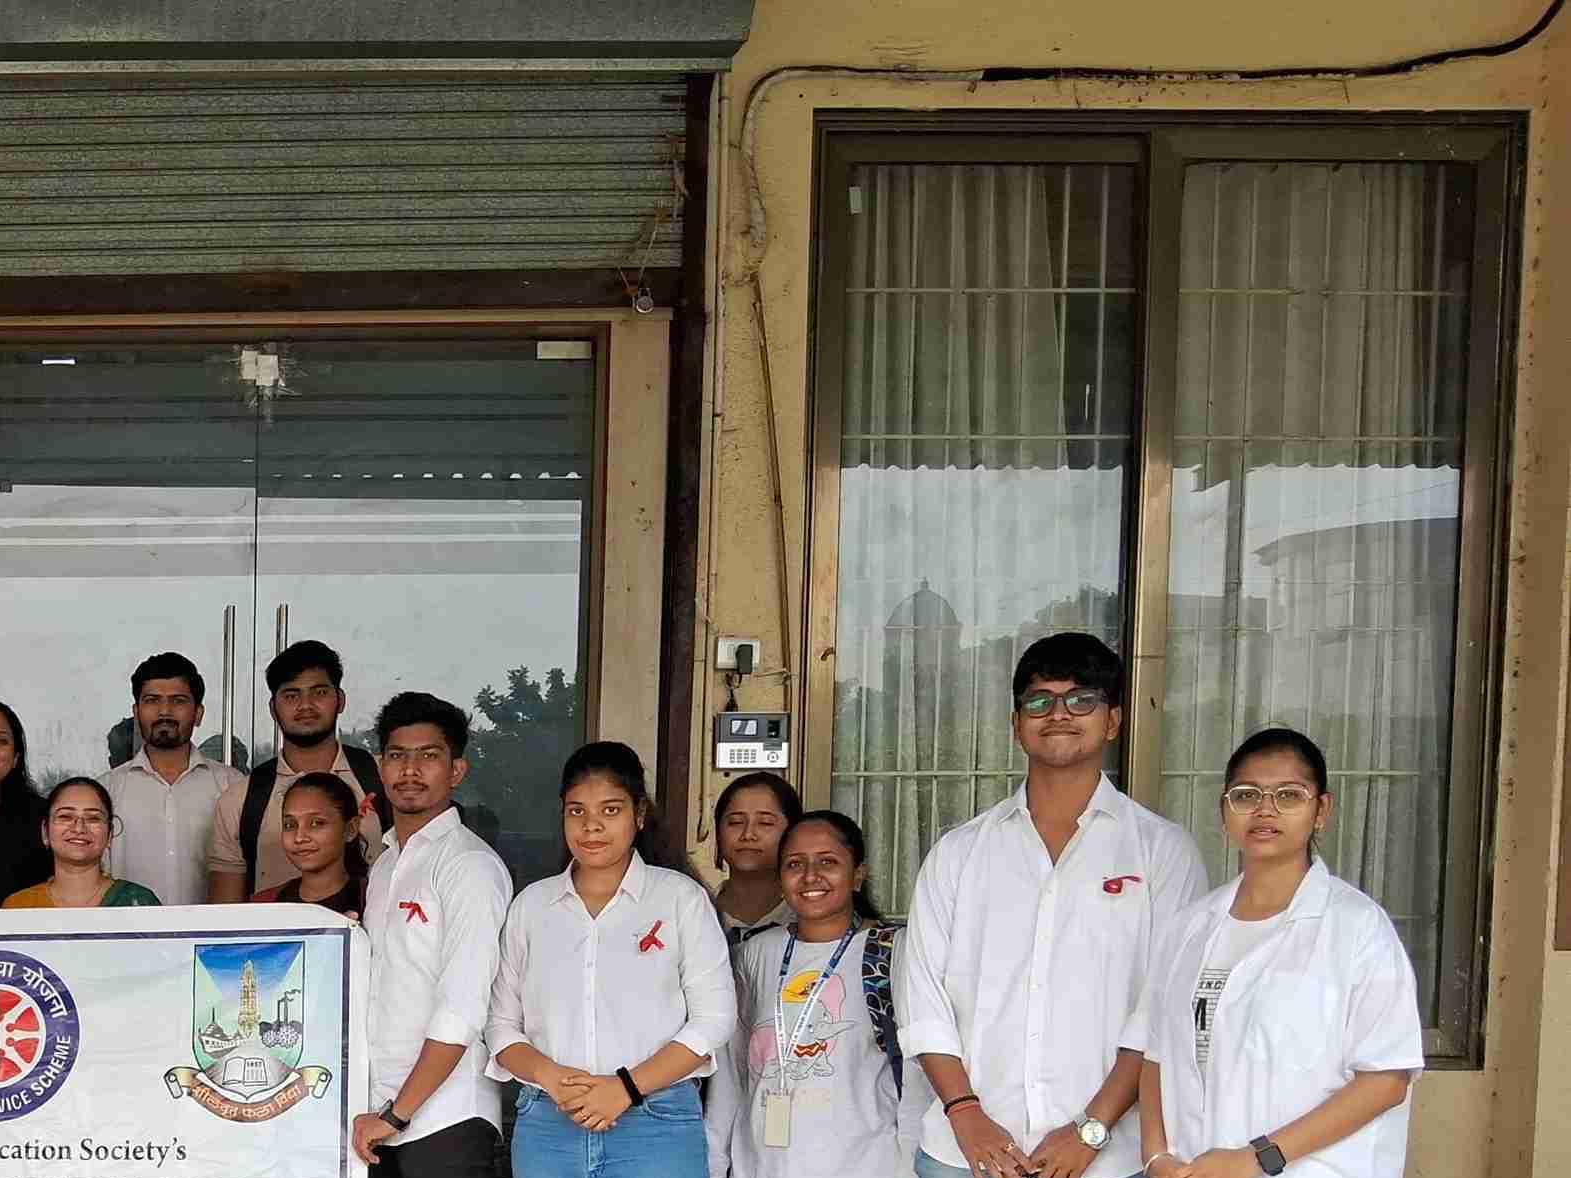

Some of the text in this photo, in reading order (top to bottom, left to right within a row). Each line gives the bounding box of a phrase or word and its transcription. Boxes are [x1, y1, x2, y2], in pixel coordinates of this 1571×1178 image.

[22, 967, 68, 1018] योजना
[31, 1035, 71, 1097] SCHEME
[80, 1138, 187, 1168] Society's
